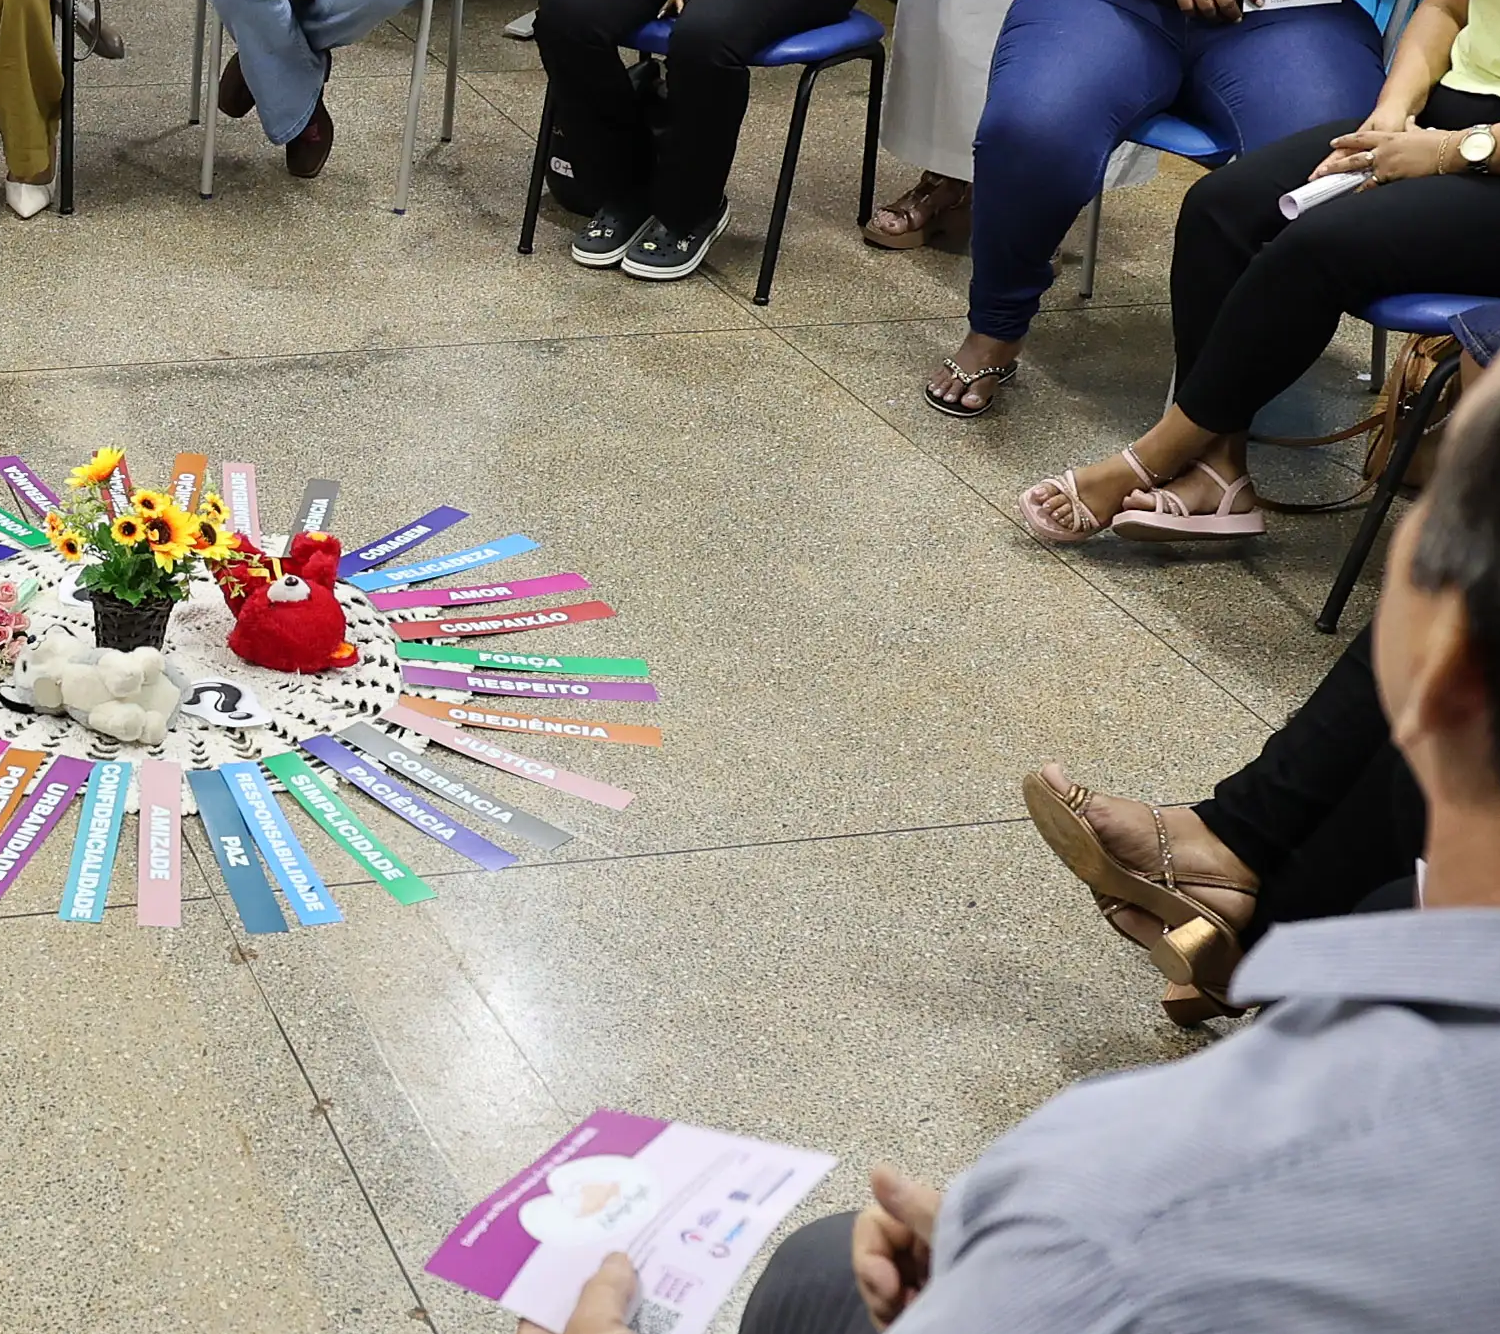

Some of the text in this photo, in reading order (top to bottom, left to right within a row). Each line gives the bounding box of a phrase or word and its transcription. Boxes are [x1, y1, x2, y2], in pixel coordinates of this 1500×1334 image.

[359, 525, 432, 561] CORAGEM
[388, 547, 500, 582] DELICADEZA
[448, 585, 513, 601] AMOR
[439, 611, 569, 633] COMPAIXÃO
[479, 652, 563, 670] FORÇA
[466, 676, 590, 696] RESPEITO
[448, 708, 609, 739] OBEDIÊNCIA
[454, 736, 557, 781] JUSTIÇA
[346, 765, 457, 841] PACIÊNCIA
[388, 749, 514, 824] COERÊNCIA
[70, 763, 122, 920] CONFIDENCIALIDADE
[150, 804, 171, 880] AMIZADE
[234, 772, 326, 913] RESPONSABILIDADE
[290, 773, 405, 882] SIMPLICIDADE
[220, 835, 249, 867] PAZ
